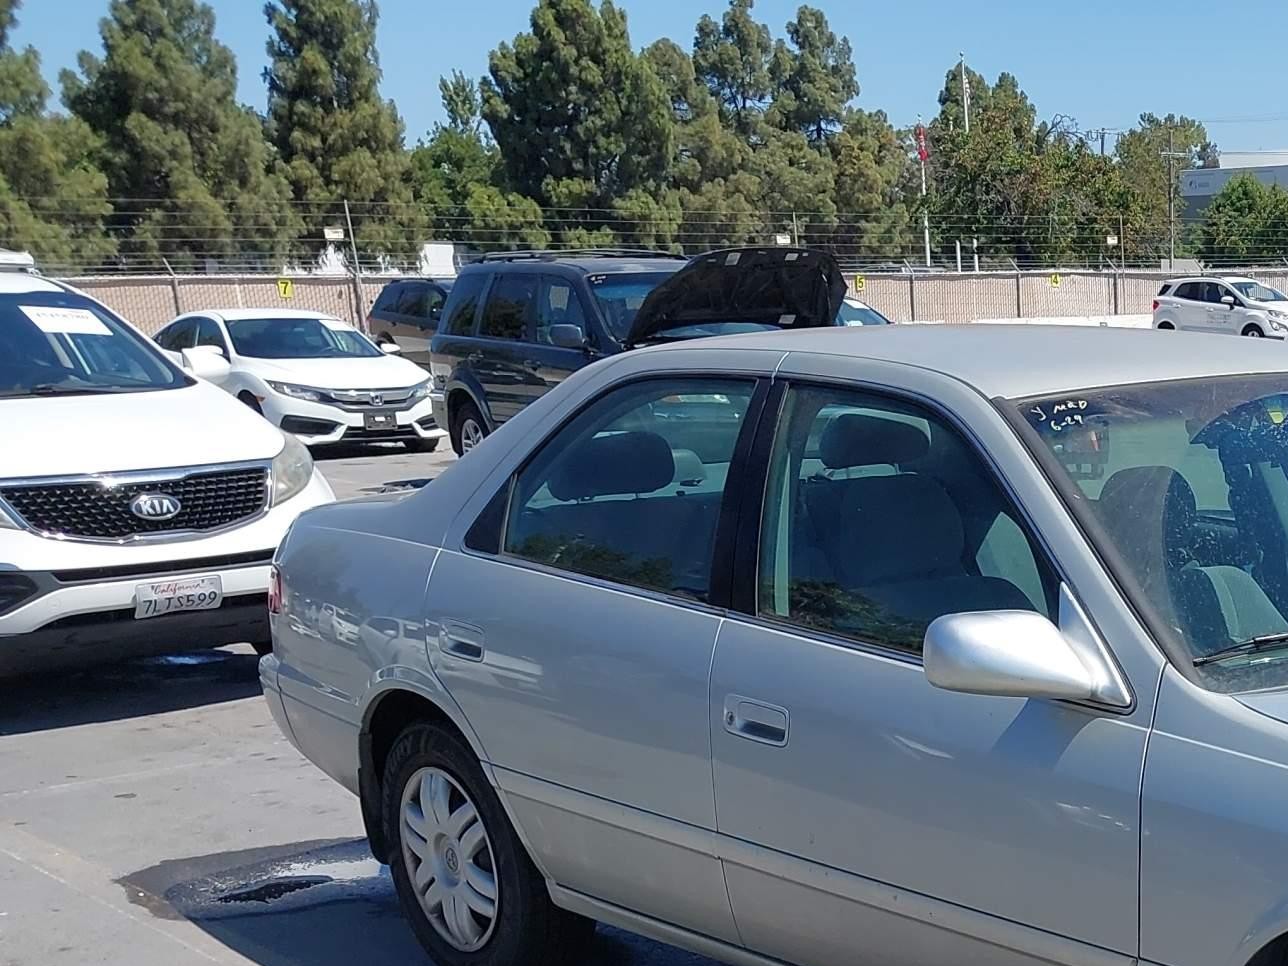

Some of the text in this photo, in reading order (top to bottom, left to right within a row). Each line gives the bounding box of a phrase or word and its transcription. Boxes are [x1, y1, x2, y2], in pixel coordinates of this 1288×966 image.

[280, 281, 289, 294] 7
[858, 277, 864, 288] 5
[138, 499, 175, 515] KIA
[143, 591, 218, 615] 7LTS599
